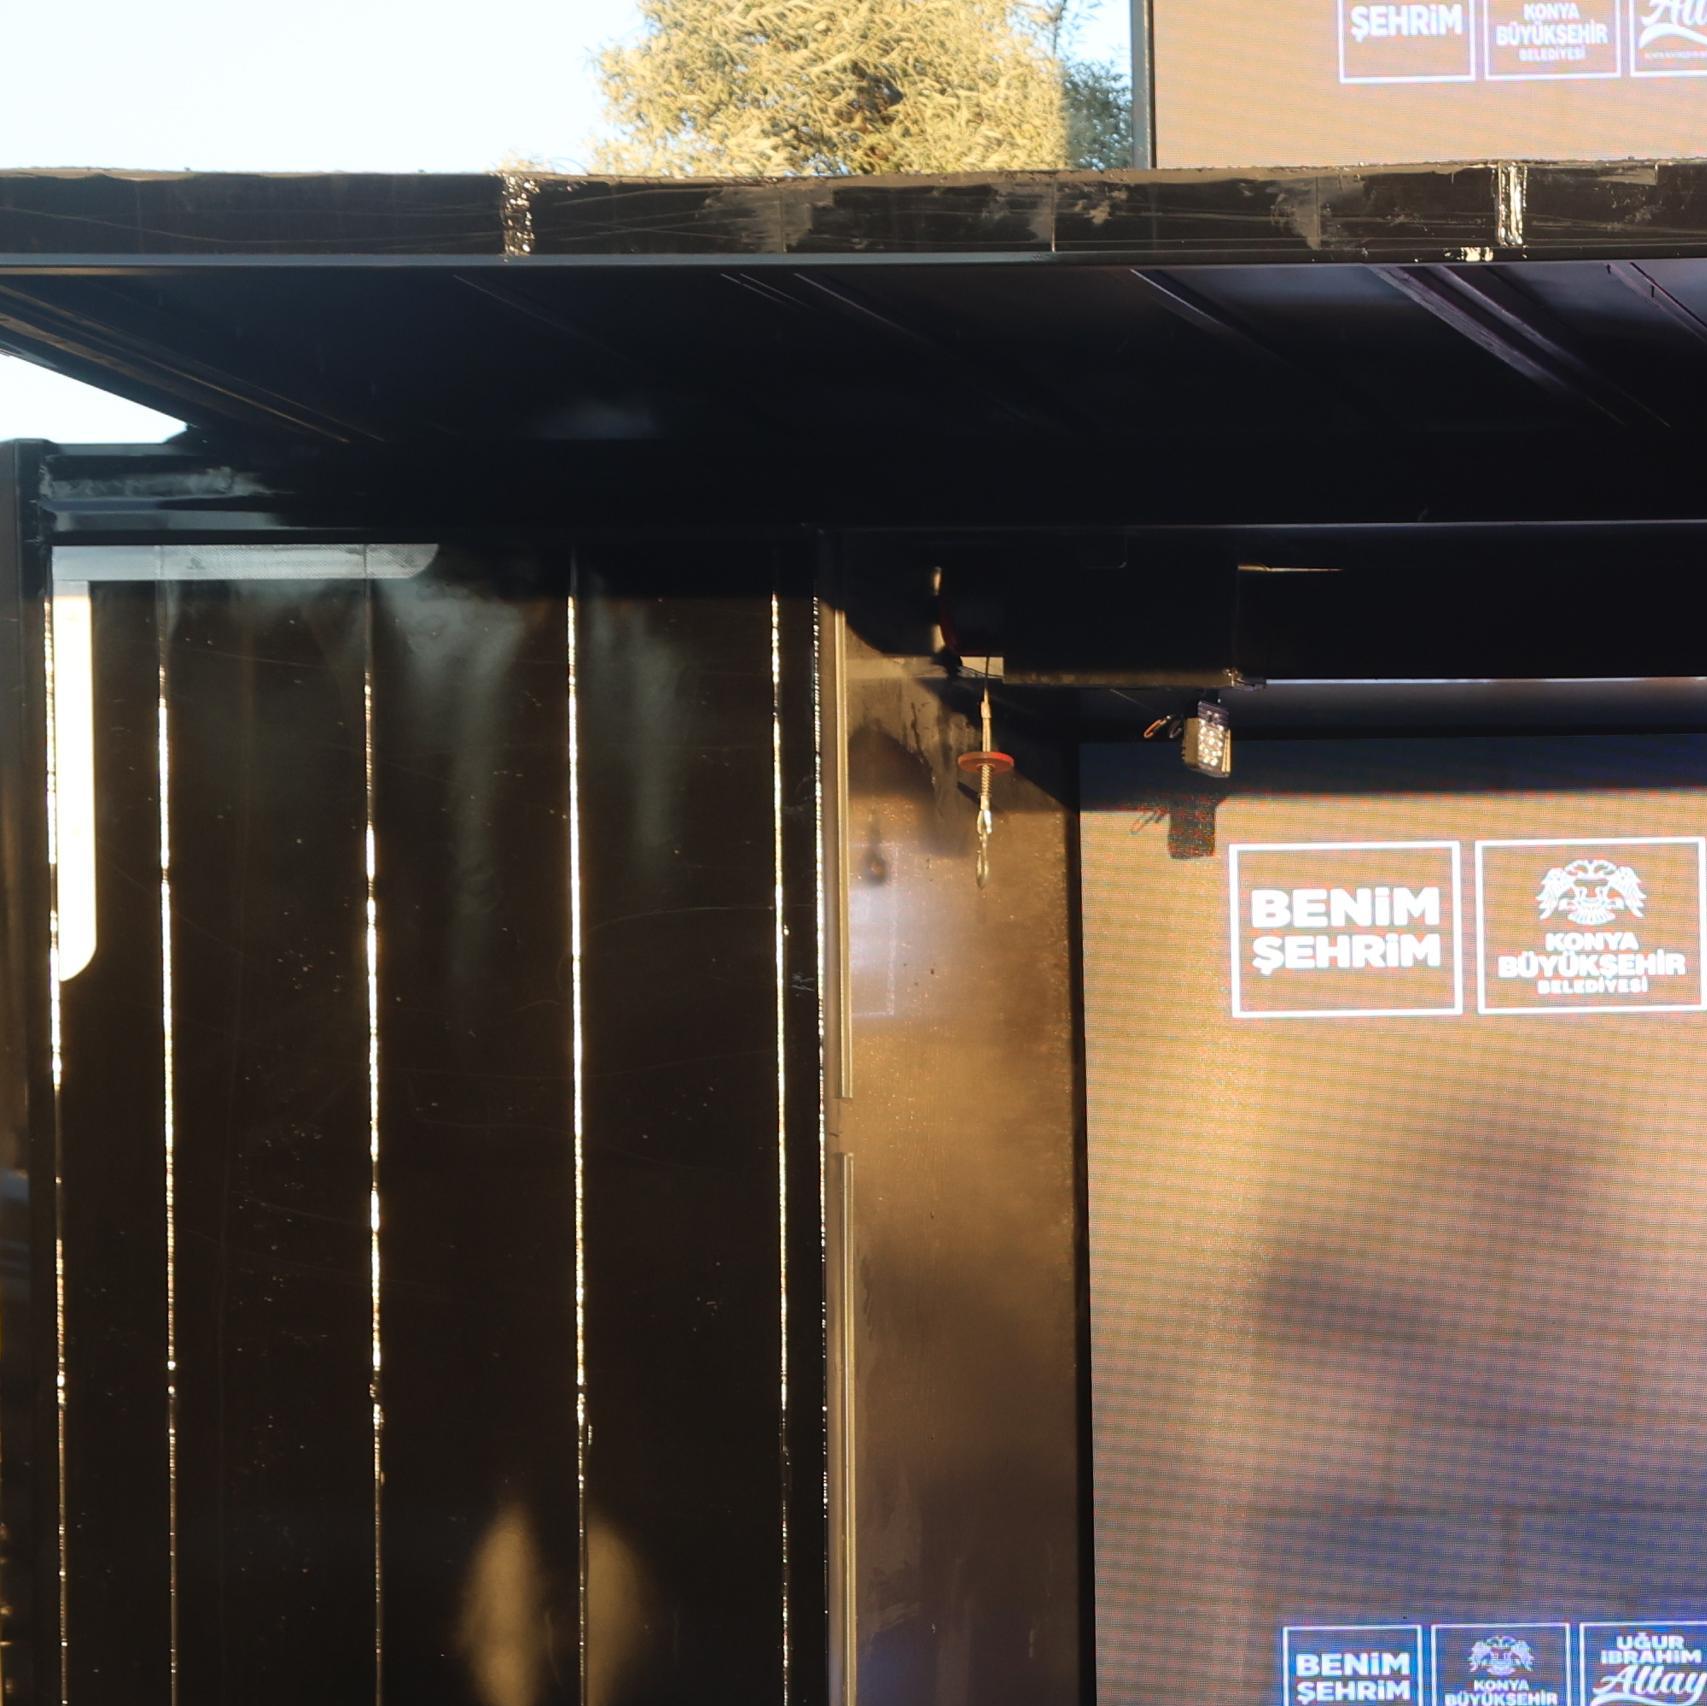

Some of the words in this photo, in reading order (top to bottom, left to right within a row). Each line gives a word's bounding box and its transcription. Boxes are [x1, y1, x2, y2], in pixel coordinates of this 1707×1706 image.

[1350, 3, 1463, 43] ŞEHRİM
[1523, 2, 1580, 22] KONYA
[1496, 18, 1609, 48] BÜYÜKŞEHİR
[1519, 45, 1586, 63] BELEDİYESİ
[1252, 886, 1440, 928] BENİM
[1545, 932, 1639, 951] KONYA
[1252, 933, 1441, 976] ŞEHRİM
[1498, 949, 1686, 980] BÜYÜKŞEHİR
[1537, 976, 1648, 994] BELEDİYESİ
[1616, 1632, 1685, 1650] UĞUR
[1297, 1653, 1410, 1677] BENİM
[1298, 1680, 1411, 1705] ŞEHRİM
[1474, 1680, 1529, 1692] KONYA
[1445, 1690, 1558, 1706] BÜYÜKŞEHİR
